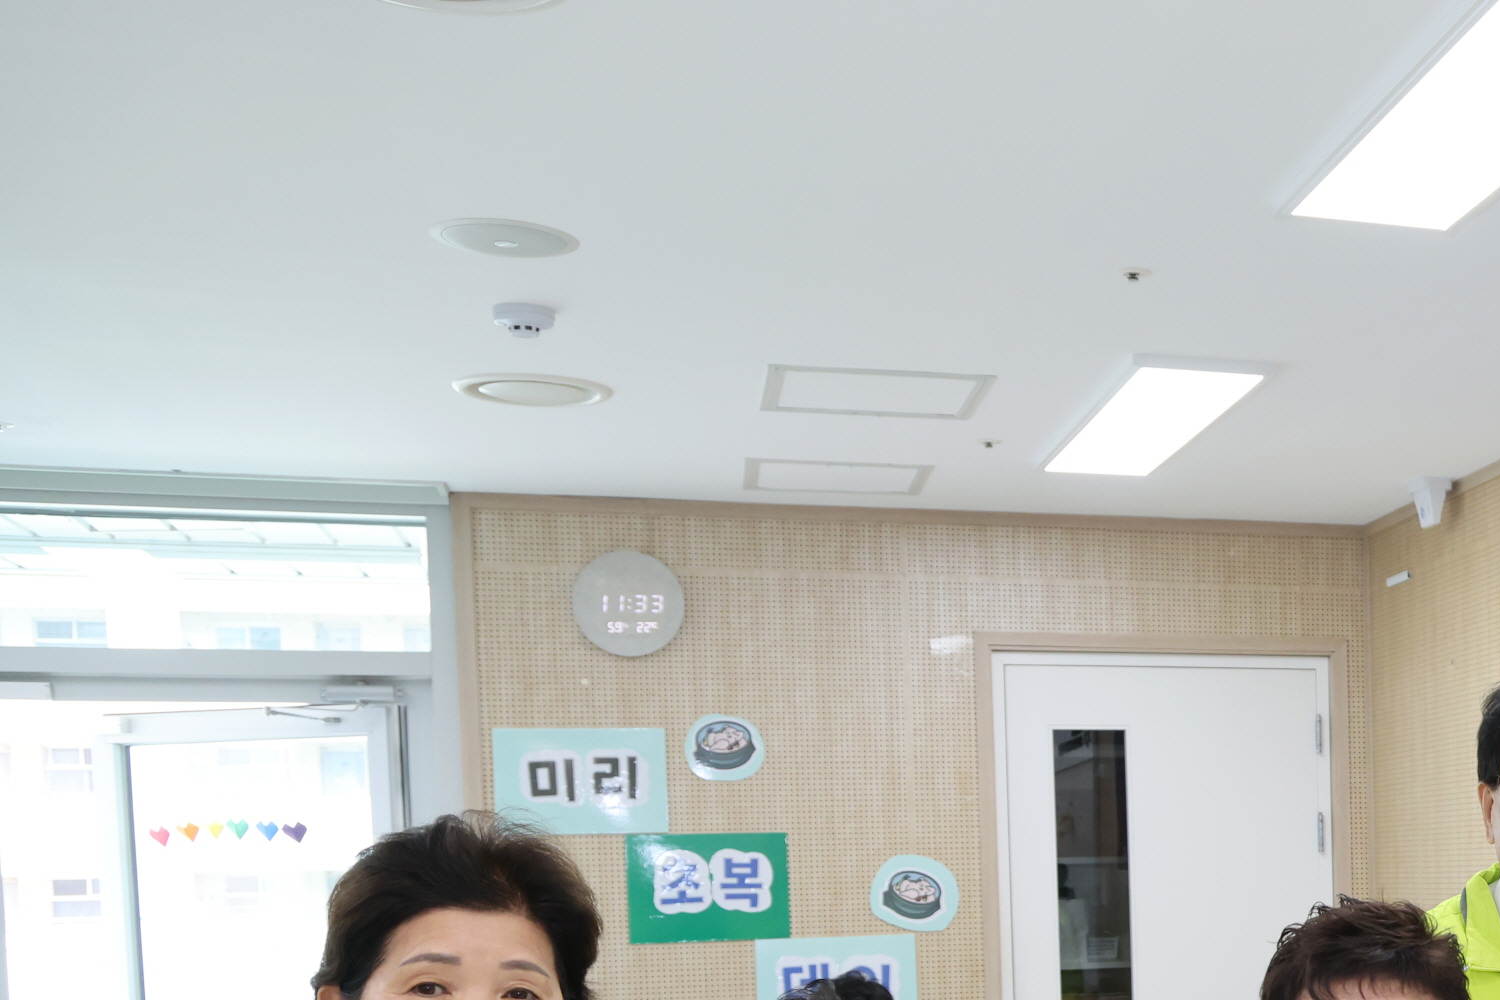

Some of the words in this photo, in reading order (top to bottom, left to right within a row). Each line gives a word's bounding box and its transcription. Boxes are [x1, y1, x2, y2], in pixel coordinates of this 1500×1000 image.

[602, 594, 665, 614] 11:33
[528, 756, 637, 802] 미리
[660, 857, 763, 909] 초복
